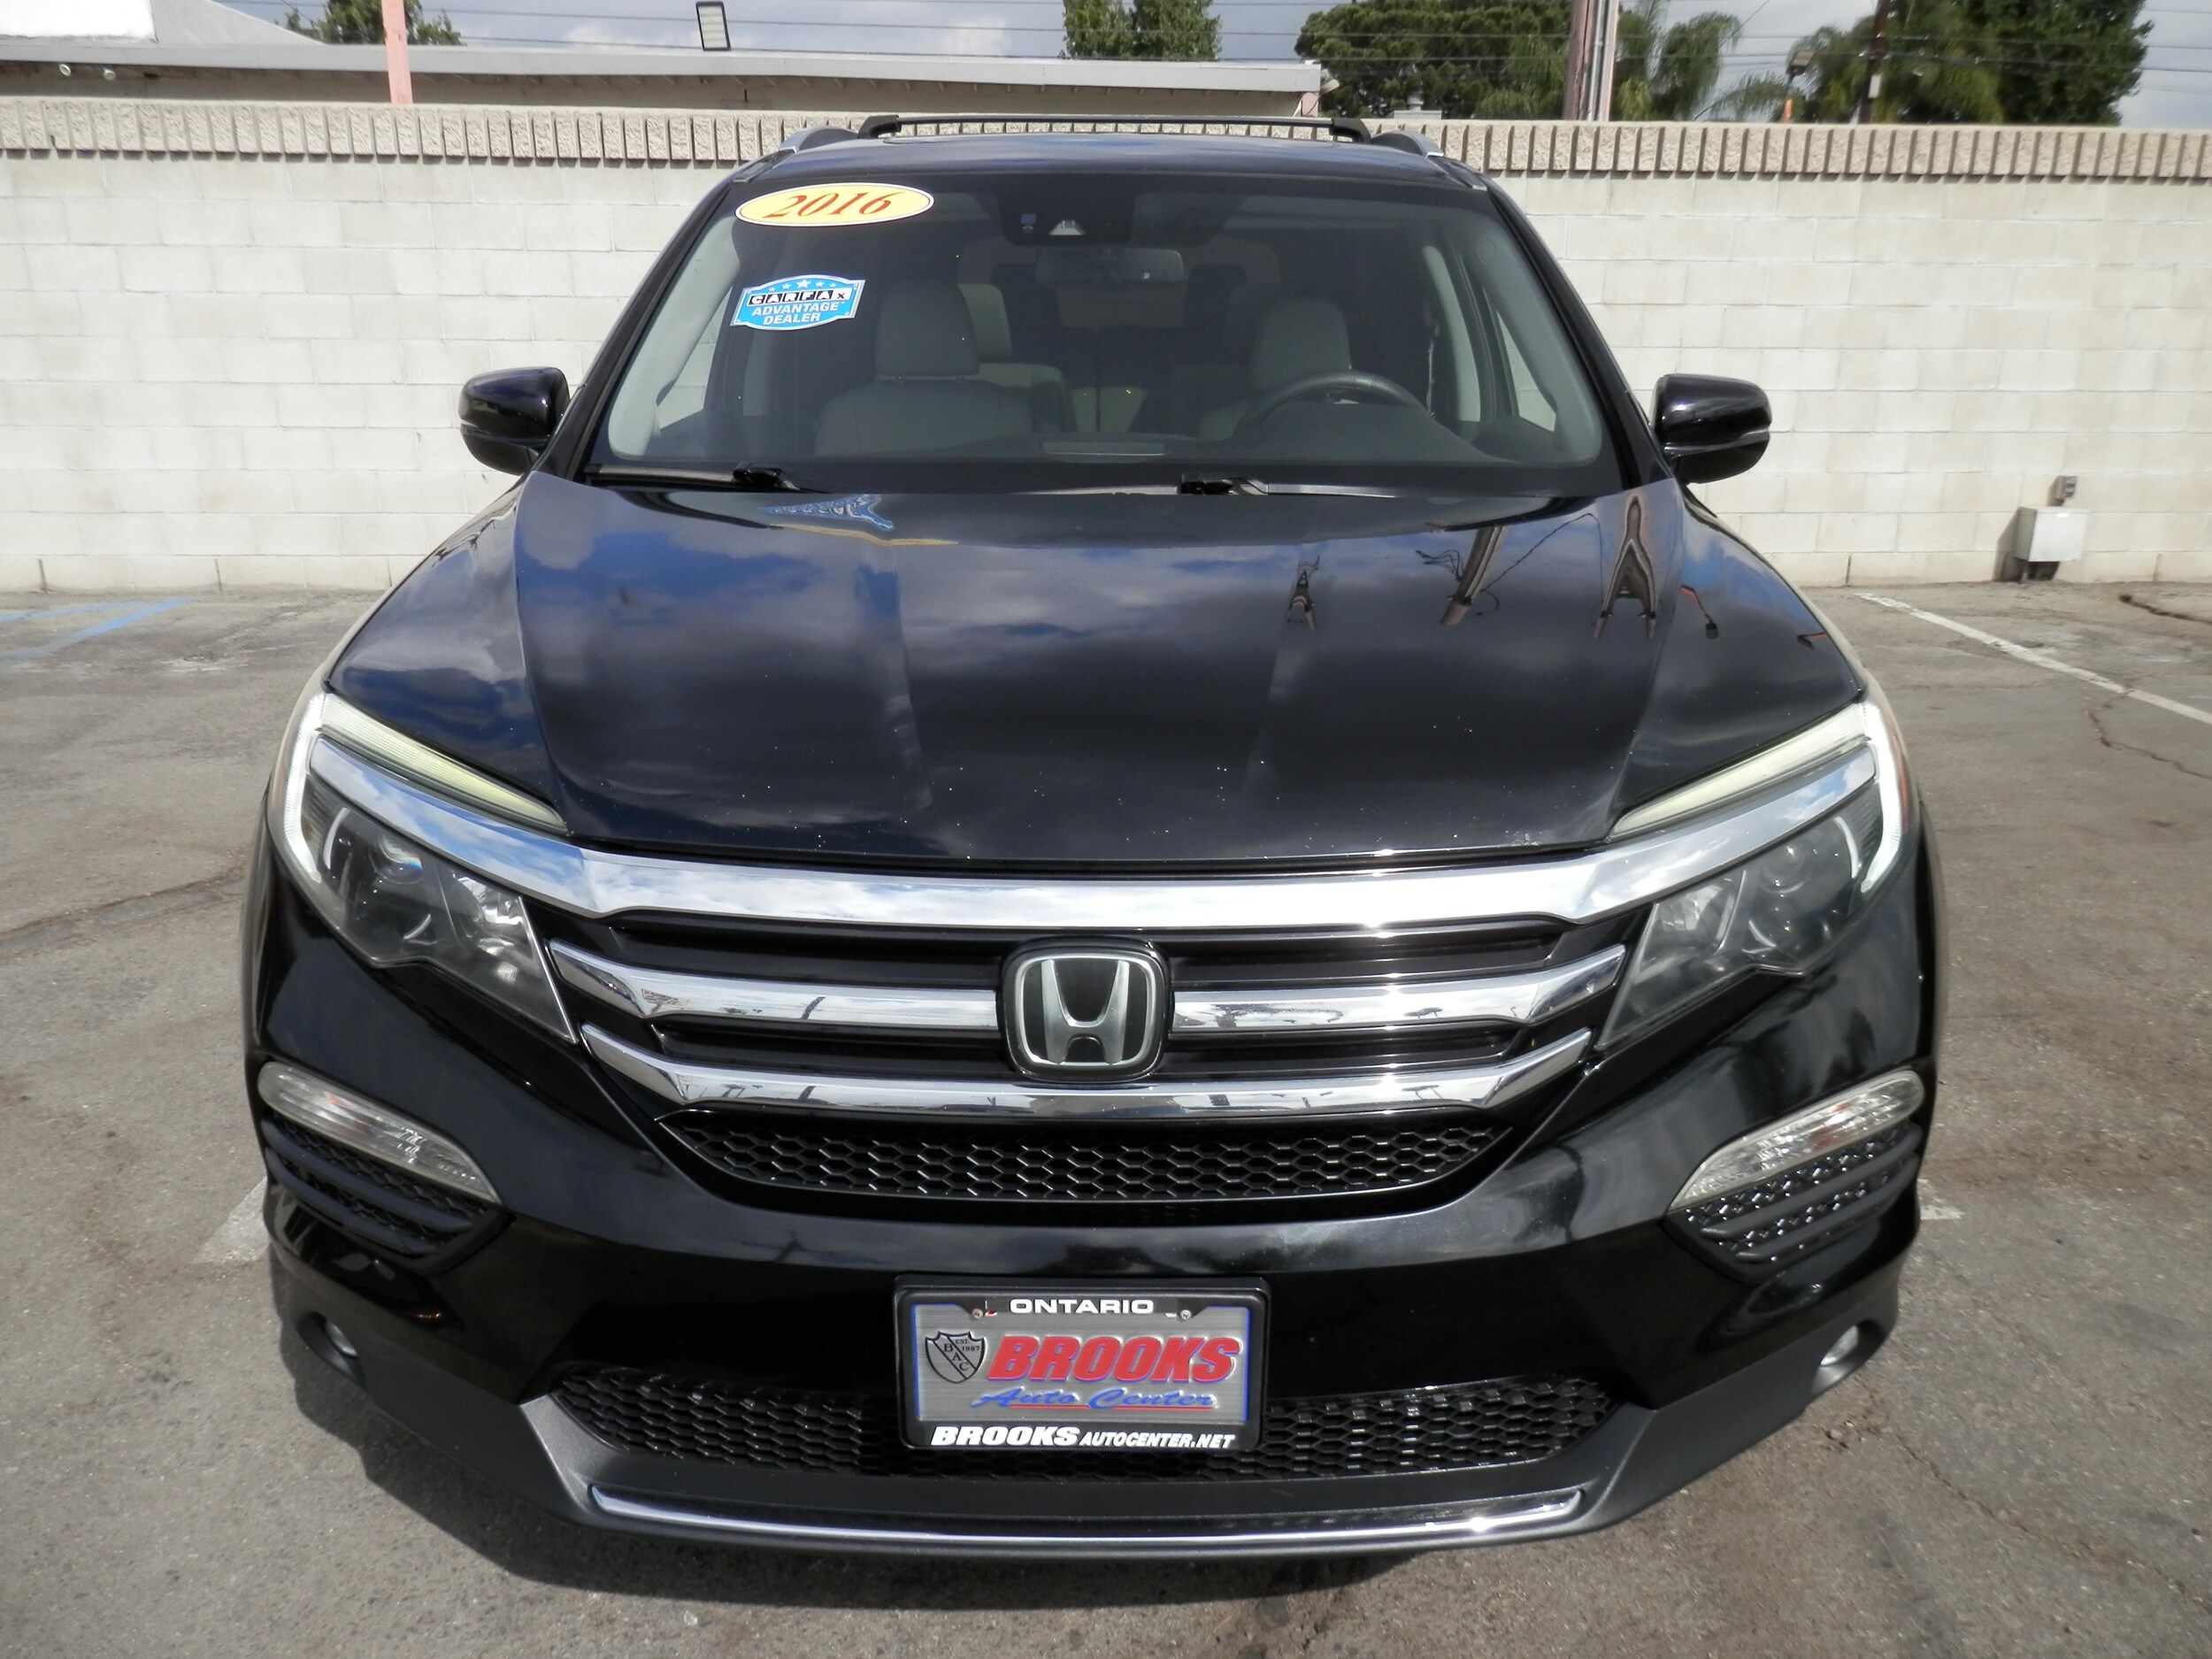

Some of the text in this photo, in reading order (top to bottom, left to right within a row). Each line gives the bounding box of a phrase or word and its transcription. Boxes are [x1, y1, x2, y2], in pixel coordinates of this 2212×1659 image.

[763, 191, 905, 219] 2016
[749, 288, 851, 305] CARFAX
[751, 301, 839, 317] ADVANTAGE
[763, 312, 821, 326] DEALER
[1010, 1299, 1154, 1314] ONTARIO
[987, 1334, 1242, 1382] BROOKS
[972, 1386, 1217, 1409] Auto Center
[931, 1426, 1236, 1448] BROOKS AUTOCENTER.NET
